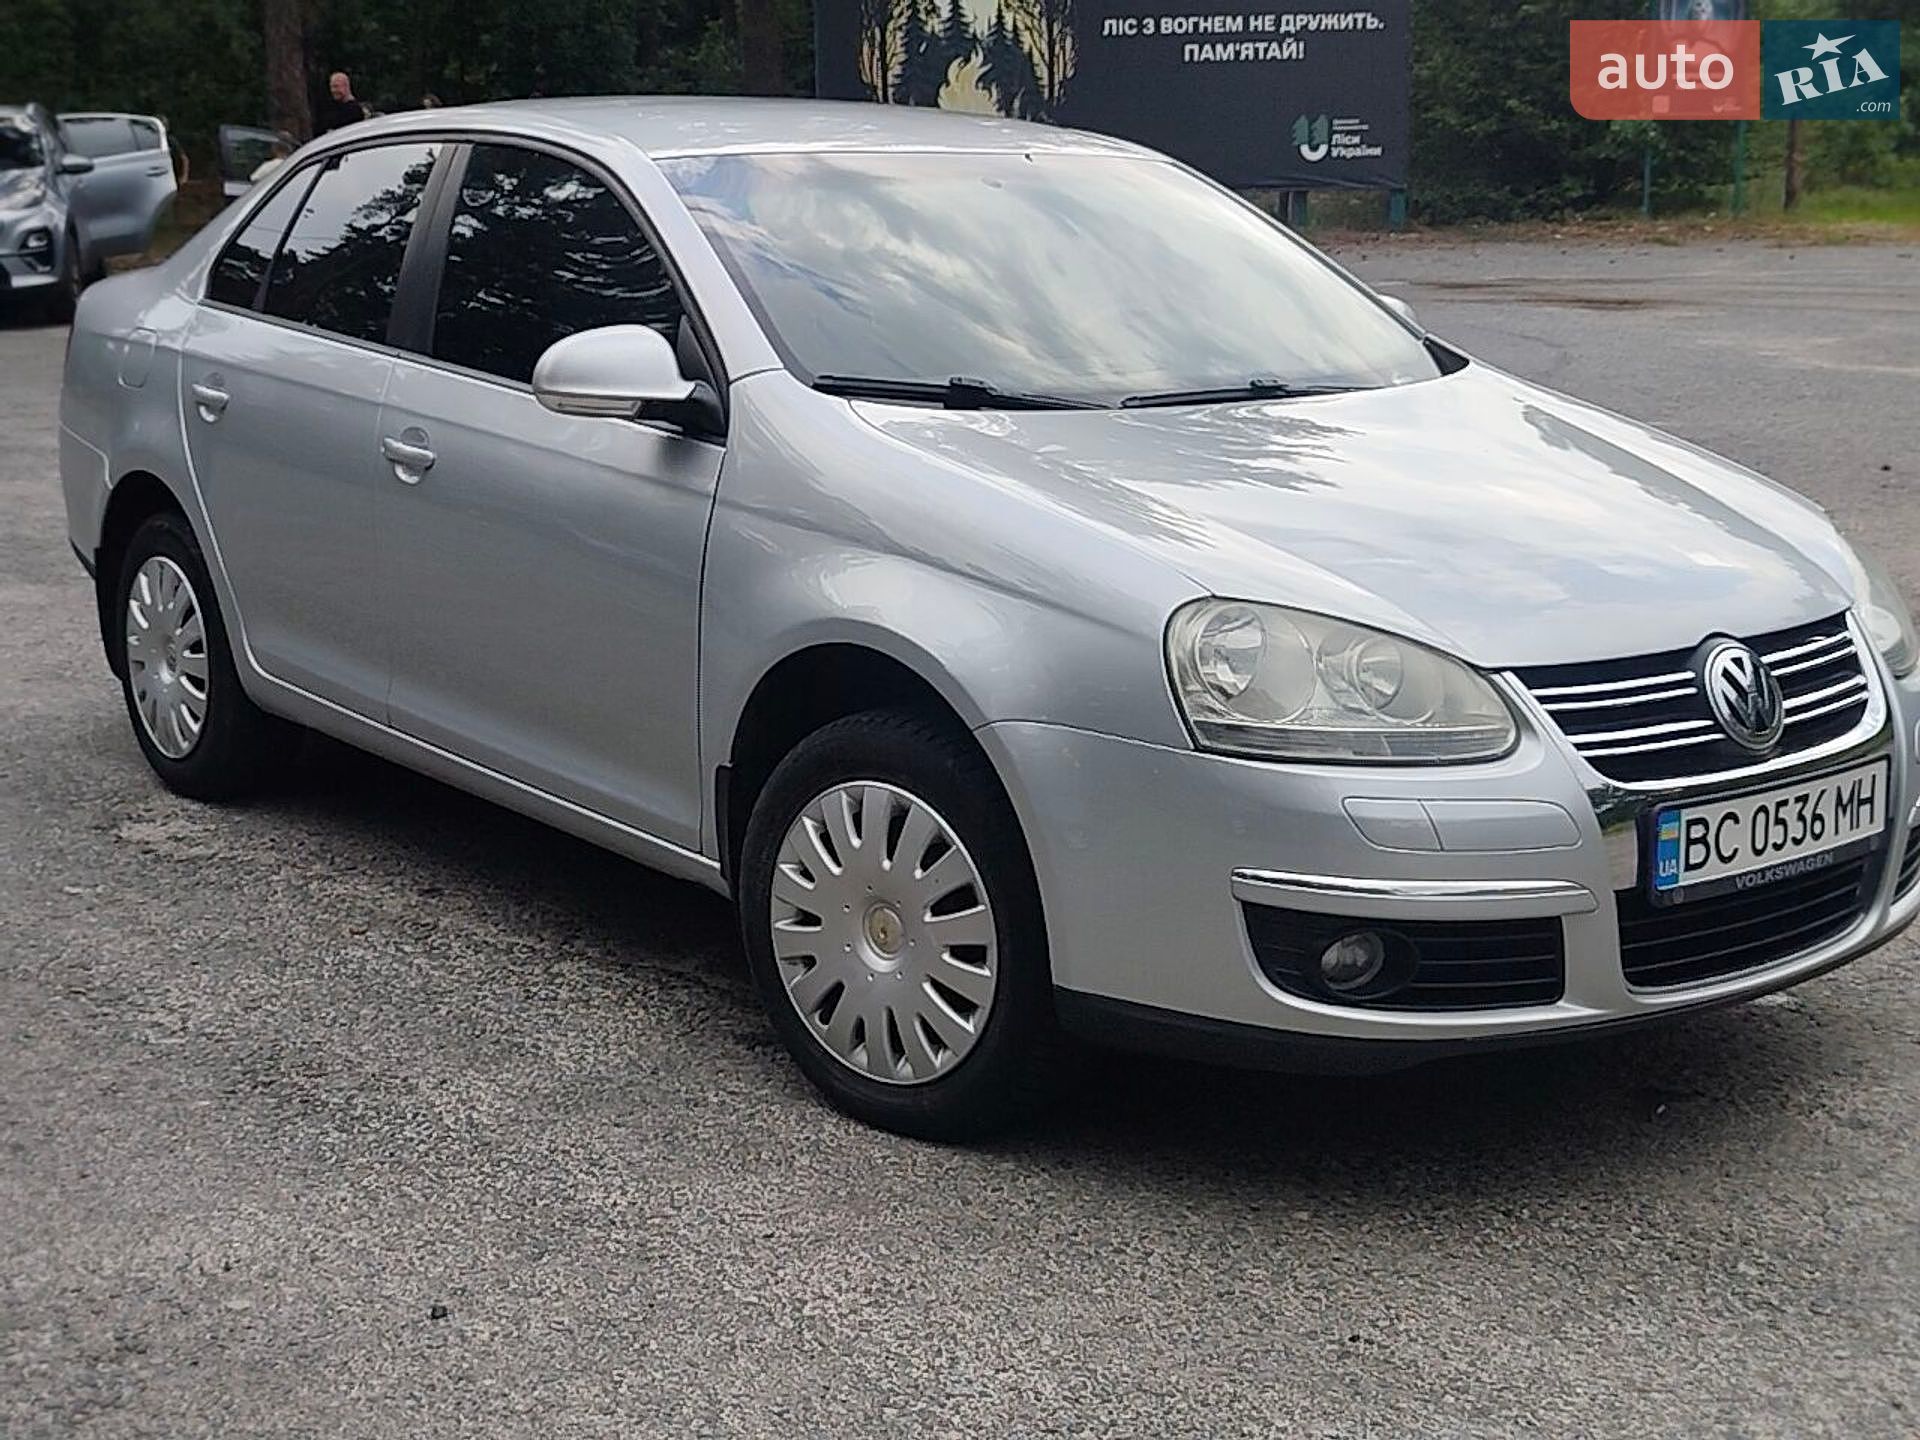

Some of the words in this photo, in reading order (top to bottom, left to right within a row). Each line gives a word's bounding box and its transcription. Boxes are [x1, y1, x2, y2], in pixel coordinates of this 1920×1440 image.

[1102, 18, 1138, 36] ЛІС
[1142, 17, 1155, 35] З
[1160, 15, 1243, 34] ВОГНЕМ
[1249, 14, 1276, 32] НЕ
[1280, 12, 1385, 34] ДРУЖИТЬ.
[1684, 811, 1740, 872] BC
[1751, 788, 1828, 857] 0536
[1834, 773, 1877, 836] MH
[1658, 858, 1677, 878] UA
[1735, 852, 1834, 889] VOLKSWAGEN
